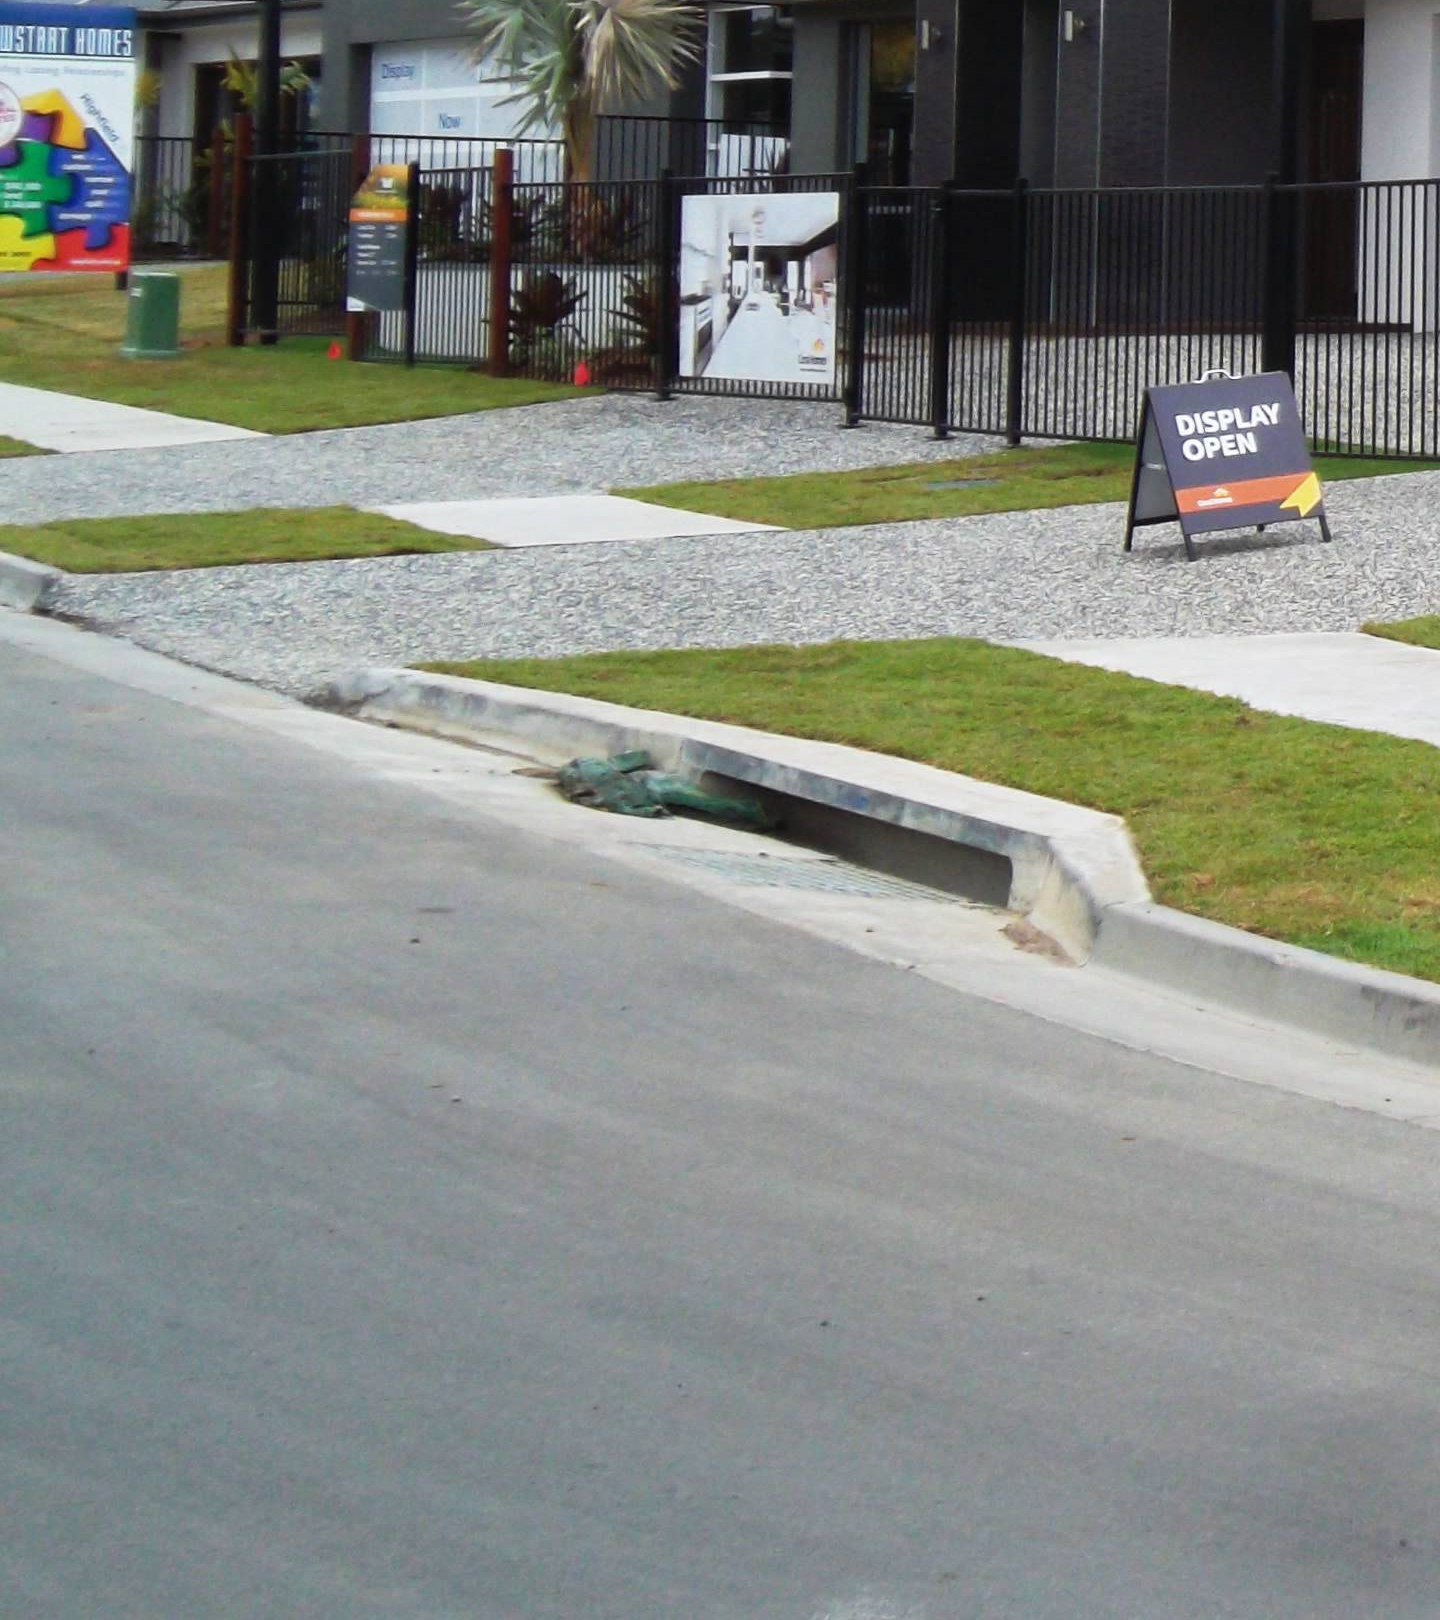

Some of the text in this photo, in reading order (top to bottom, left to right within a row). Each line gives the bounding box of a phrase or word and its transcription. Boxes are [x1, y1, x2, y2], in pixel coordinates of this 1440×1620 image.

[0, 24, 133, 57] WSTART HOMES
[381, 62, 417, 79] Display
[438, 112, 462, 129] Now
[1175, 402, 1281, 437] DISPLAY
[1182, 432, 1258, 462] OPEN
